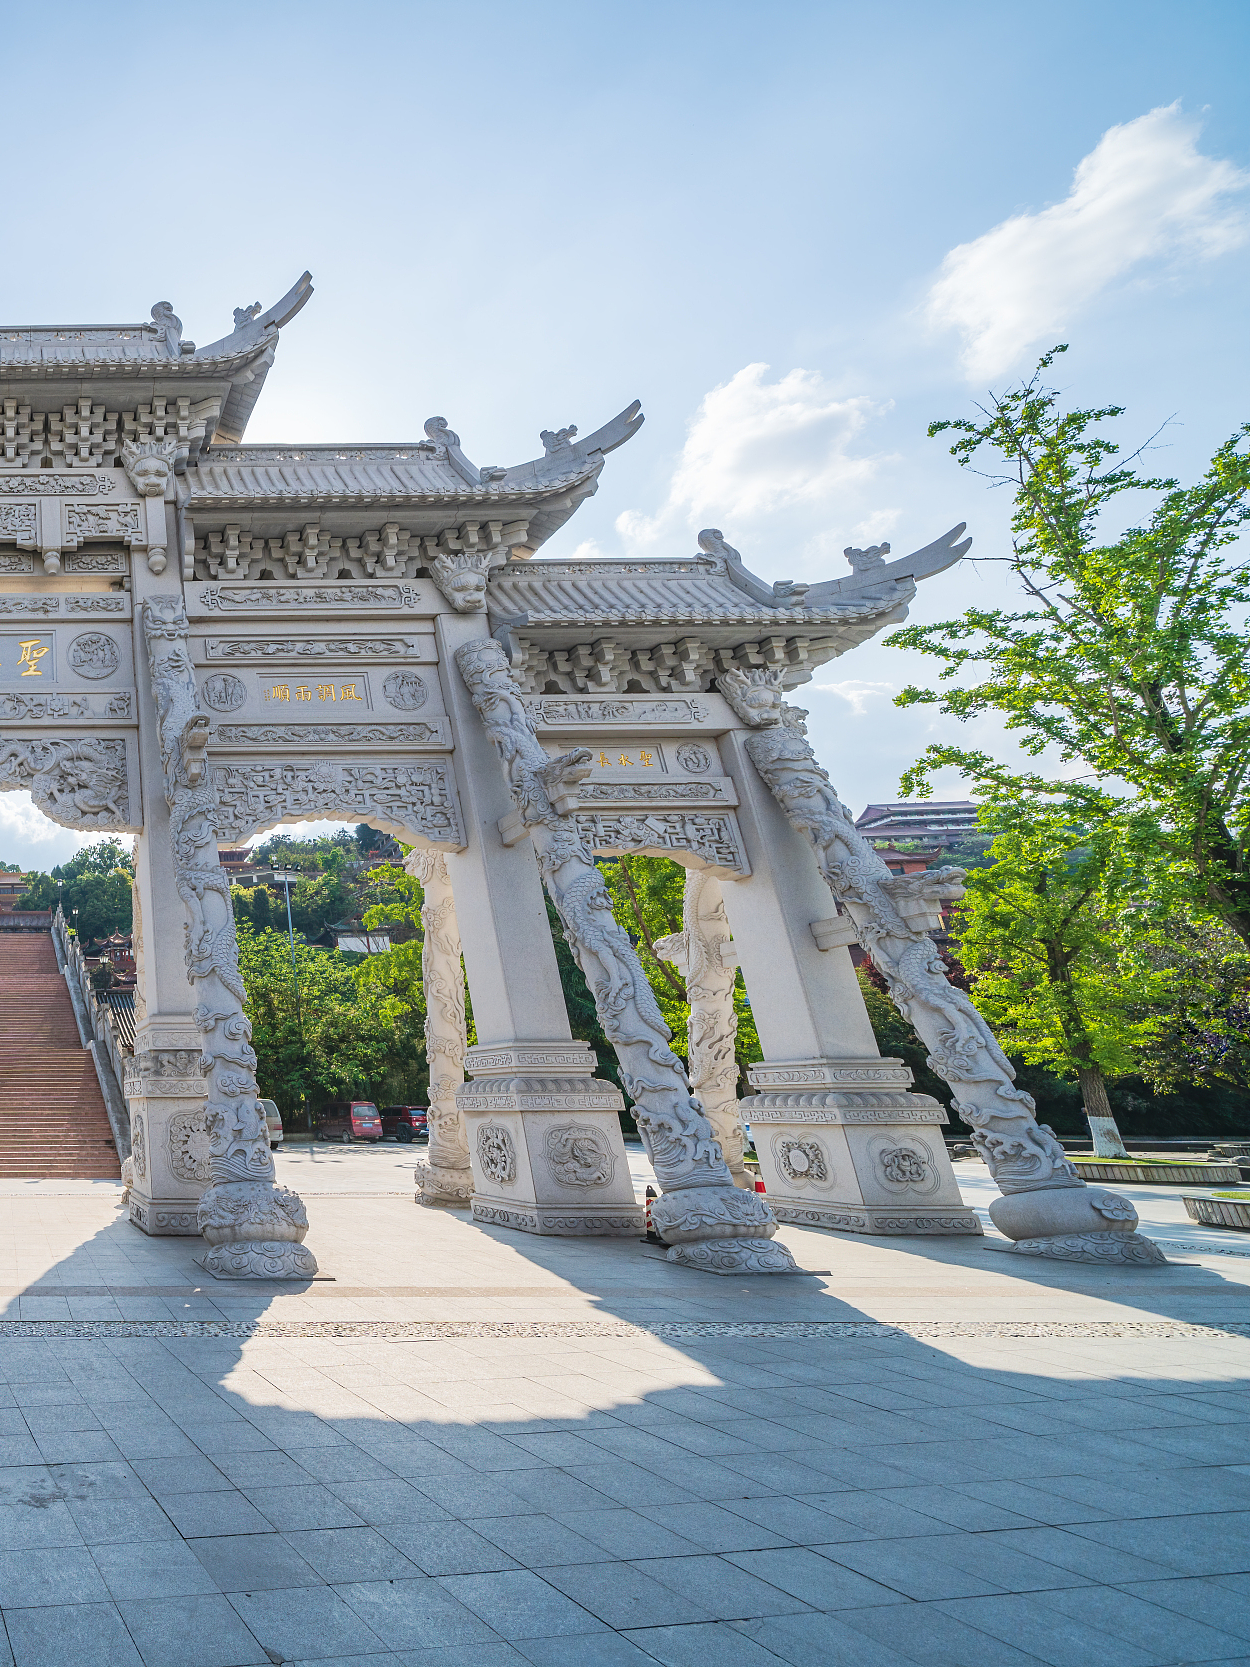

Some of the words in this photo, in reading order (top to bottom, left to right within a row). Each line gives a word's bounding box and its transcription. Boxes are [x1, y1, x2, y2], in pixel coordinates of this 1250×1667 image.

[271, 683, 363, 703] 風調雨順
[595, 750, 654, 768] 聖水長
